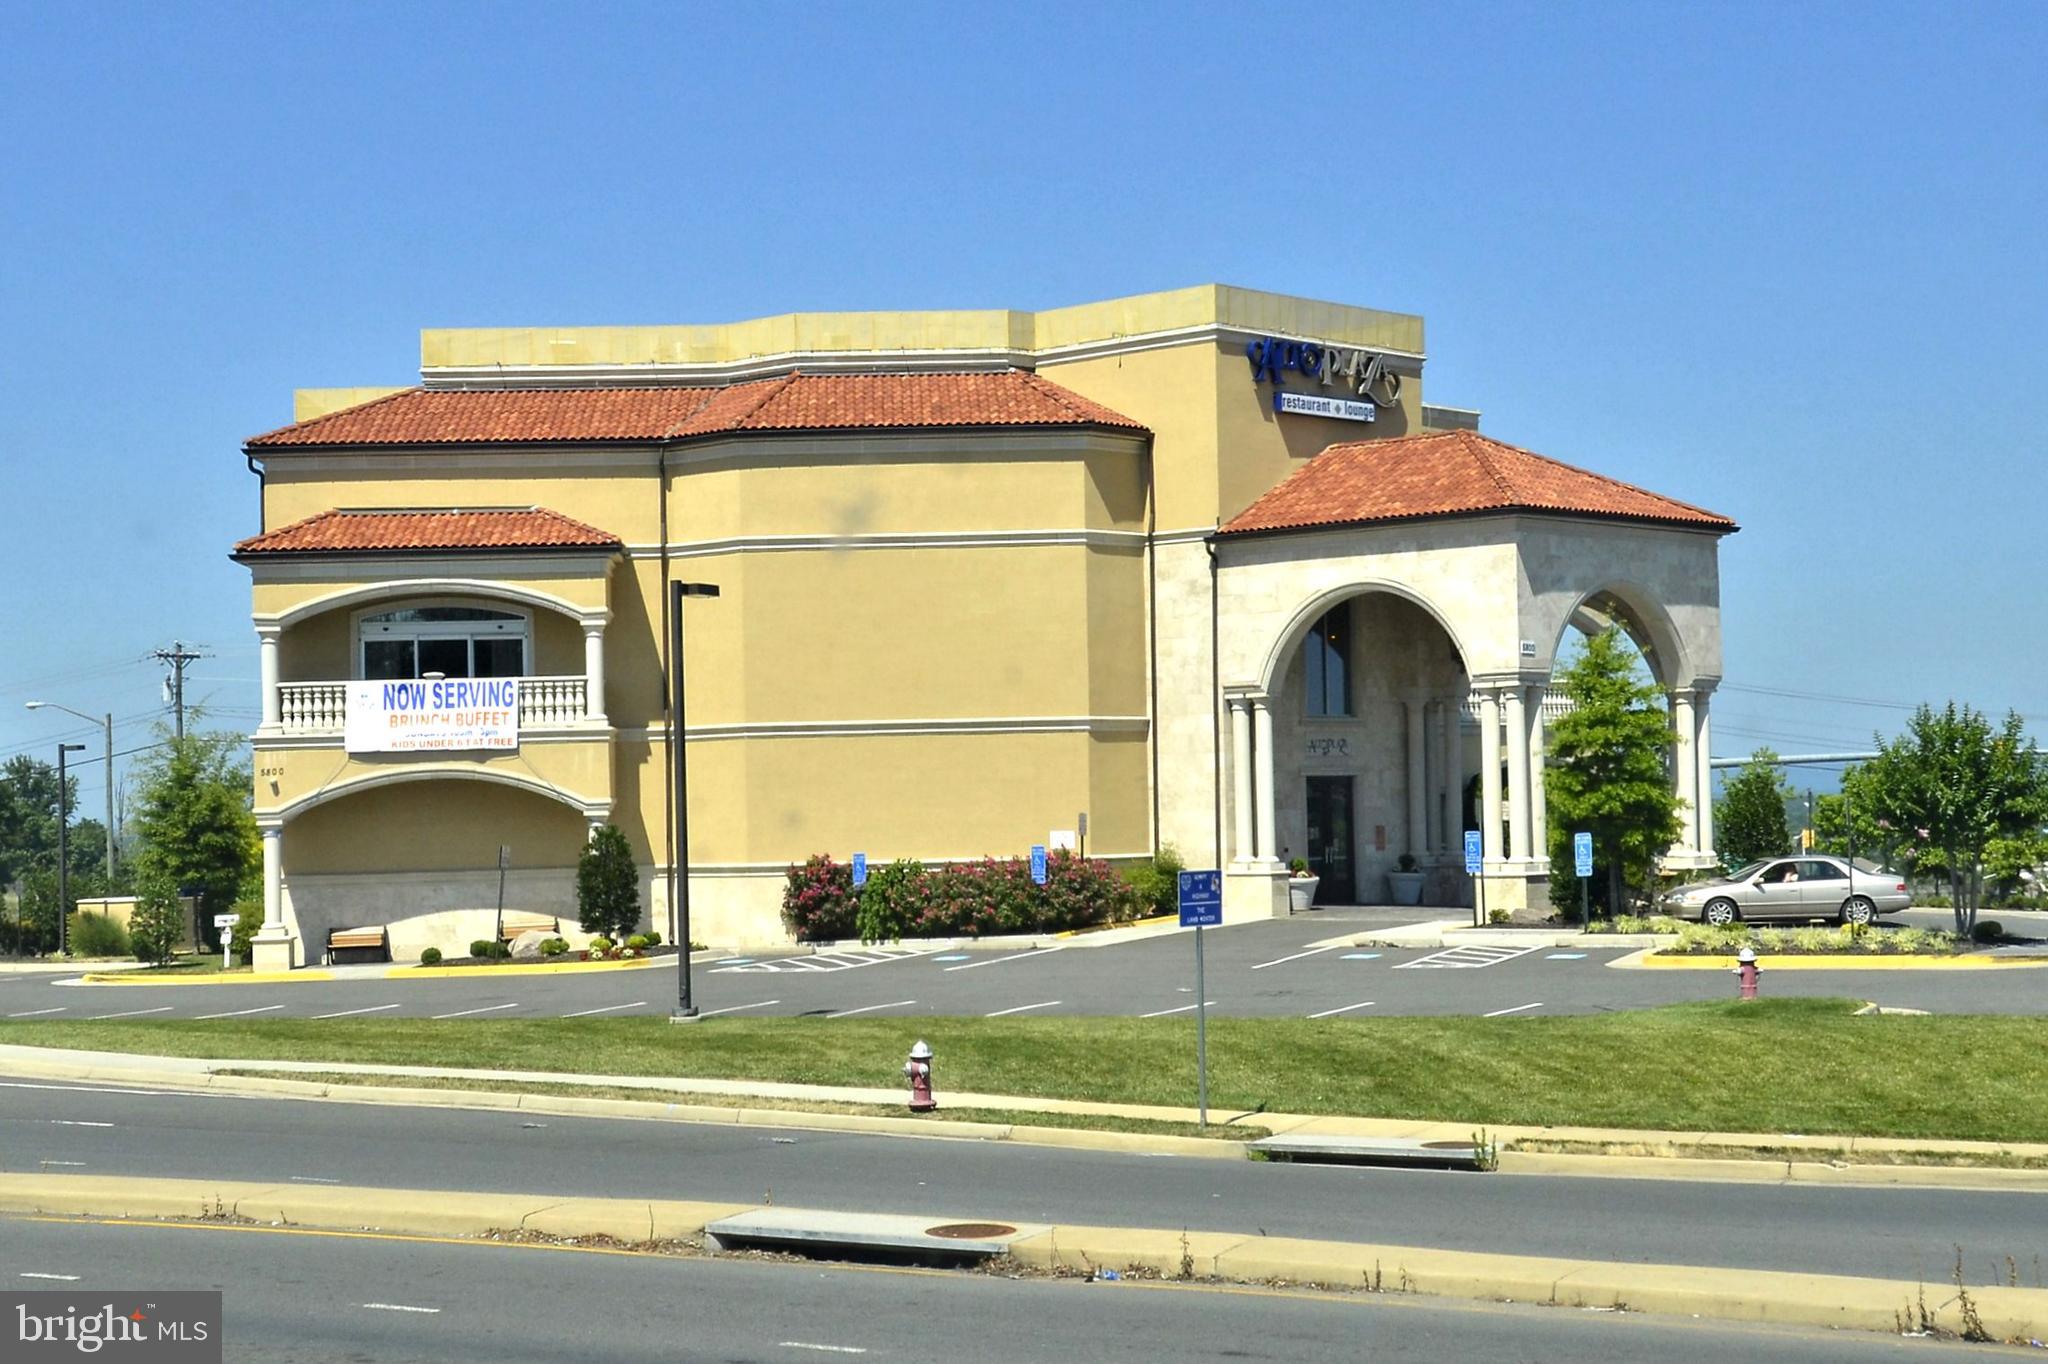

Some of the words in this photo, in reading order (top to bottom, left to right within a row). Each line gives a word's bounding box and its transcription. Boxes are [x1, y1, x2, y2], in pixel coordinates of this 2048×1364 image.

[1282, 397, 1331, 413] restaurant
[1344, 400, 1375, 421] lounge
[383, 683, 426, 711] NOW
[433, 681, 514, 709] SERVING
[389, 713, 450, 728] BRUNCH
[456, 711, 510, 726] BUFFET
[391, 740, 416, 749] KIDS
[419, 739, 454, 748] UNDER
[488, 737, 513, 747] FREE
